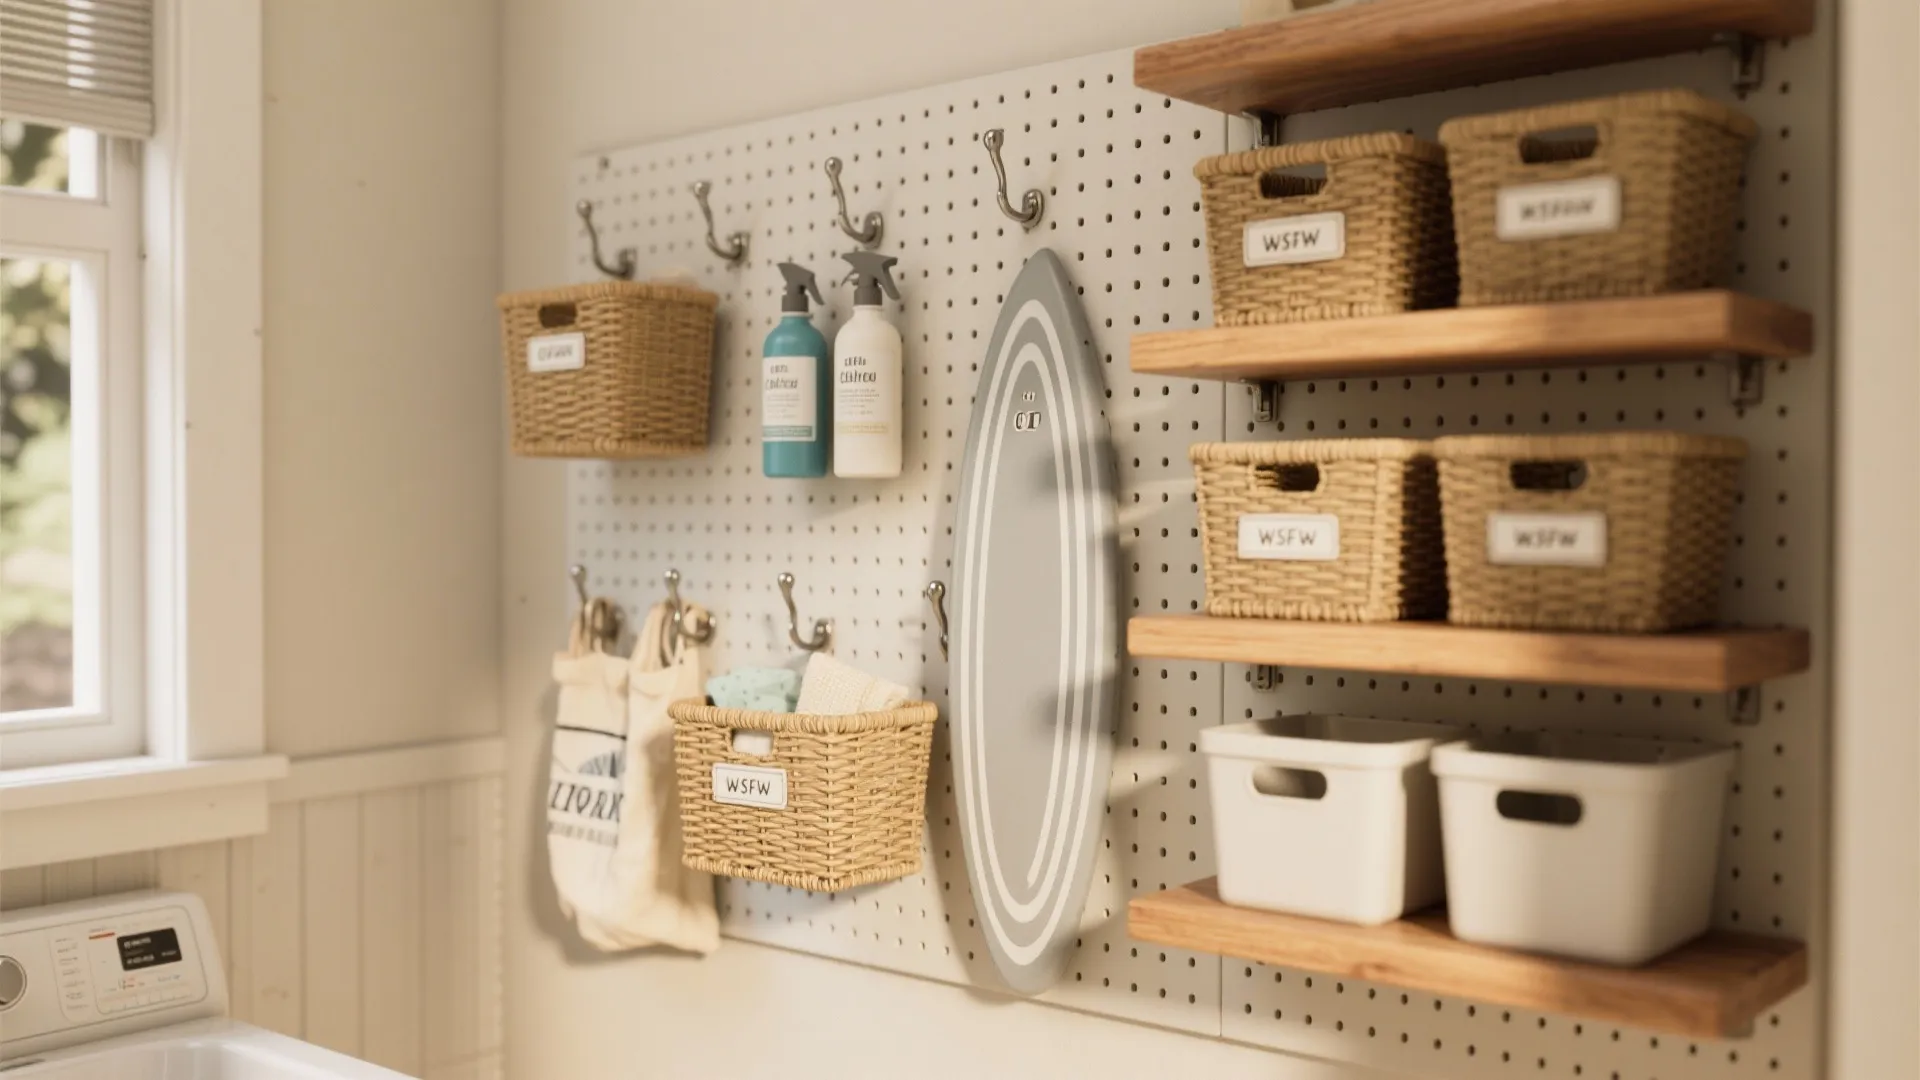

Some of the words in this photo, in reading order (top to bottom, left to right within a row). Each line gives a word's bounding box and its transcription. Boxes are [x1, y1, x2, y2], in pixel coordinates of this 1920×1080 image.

[1263, 229, 1320, 252] WSFW
[1258, 528, 1316, 547] WSFW
[727, 776, 770, 796] WSFW
